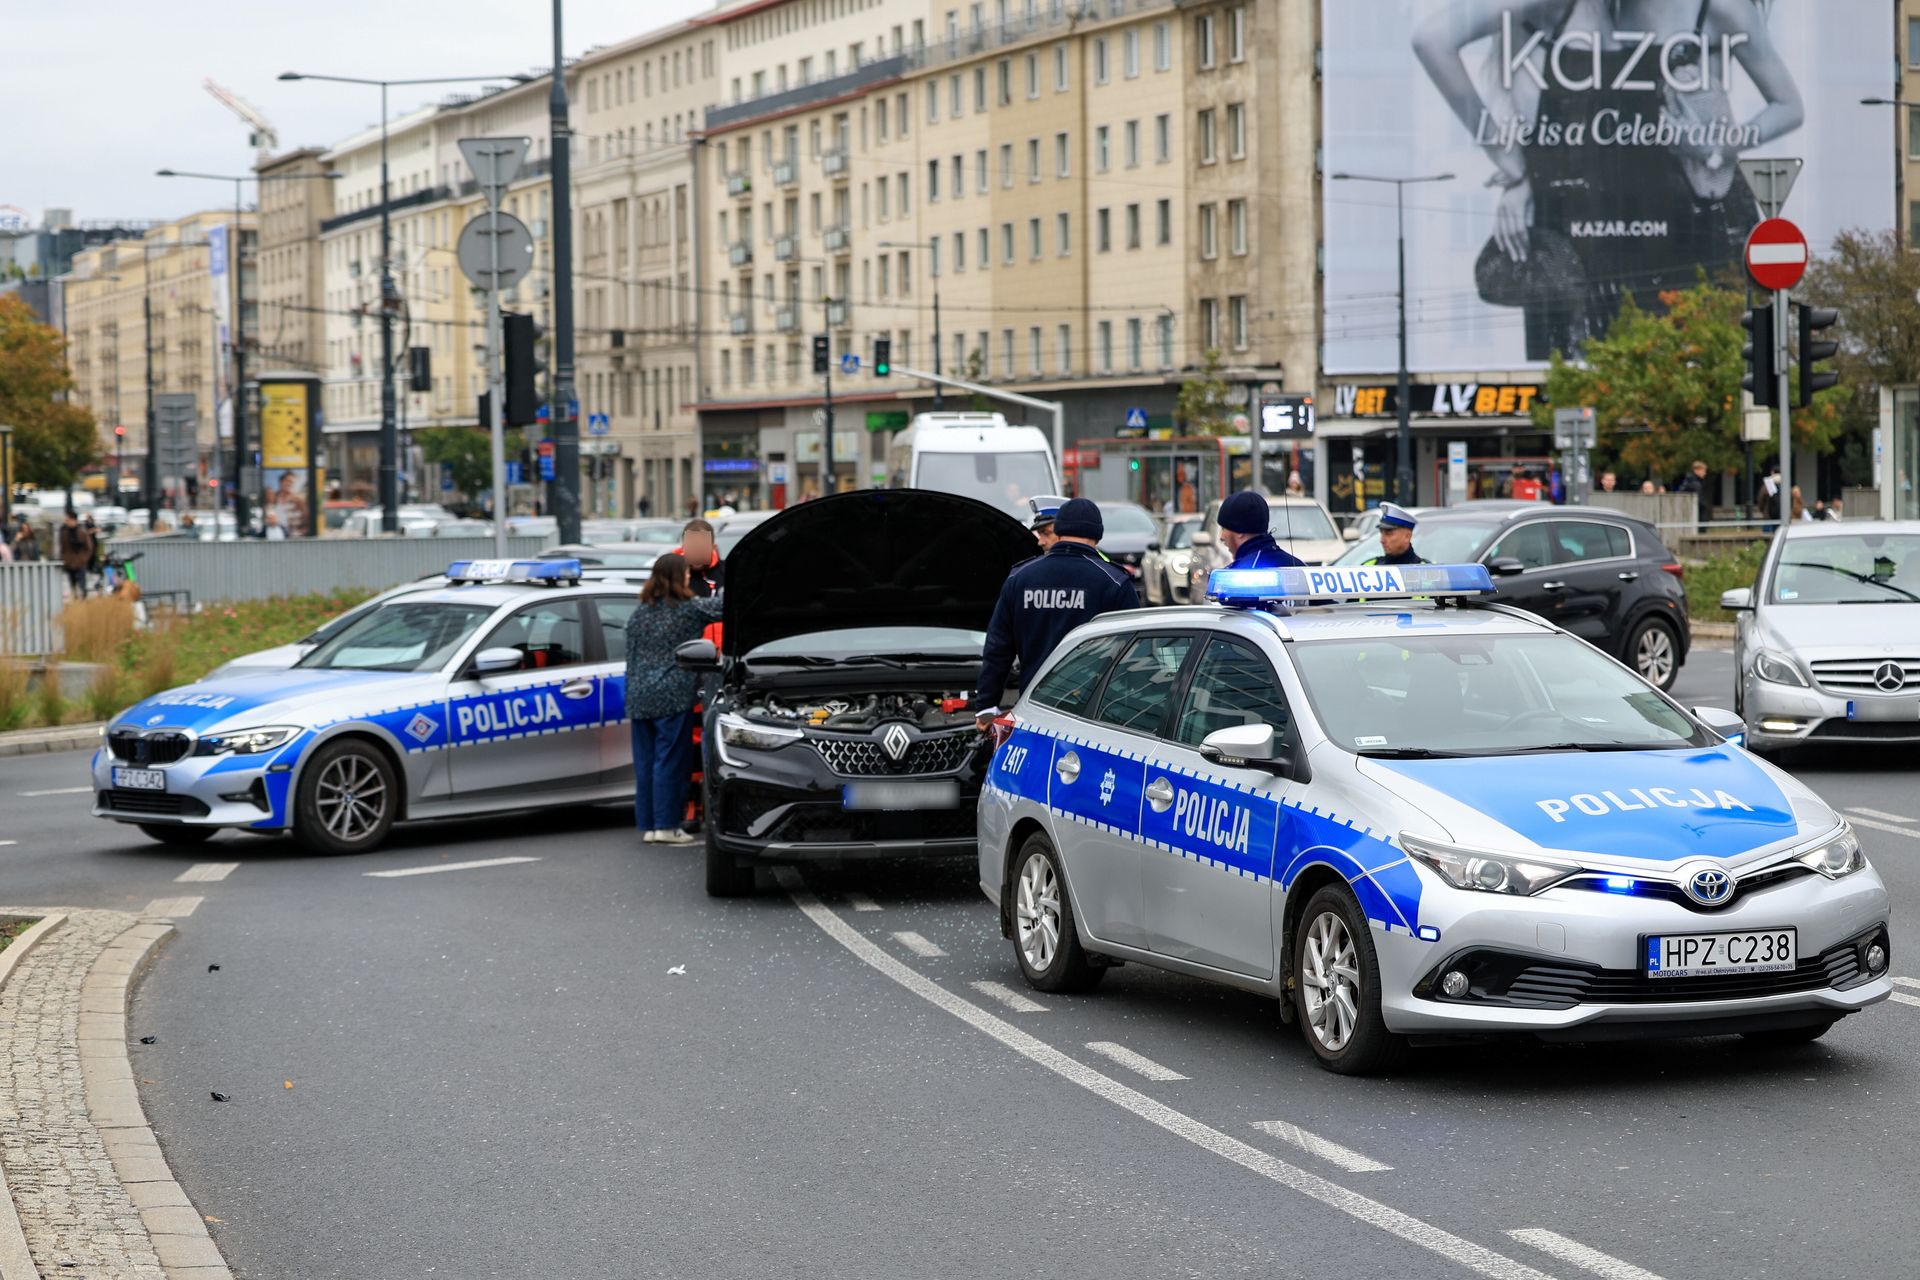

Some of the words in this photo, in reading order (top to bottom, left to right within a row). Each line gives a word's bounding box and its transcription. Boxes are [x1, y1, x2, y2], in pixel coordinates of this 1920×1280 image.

[1502, 9, 1748, 91] kazar
[1476, 109, 1533, 152] Life
[1538, 115, 1560, 146] is
[1564, 123, 1584, 146] a
[1591, 108, 1760, 147] Celebration
[1571, 220, 1668, 237] KAZAR.COM
[470, 563, 506, 577] POLICJA
[1310, 570, 1400, 593] POLICJA
[1024, 589, 1085, 609] POLICJA
[457, 693, 563, 736] POLICJA
[1172, 787, 1250, 855] POLICJA
[1535, 787, 1755, 823] POLICJA
[1649, 958, 1659, 966] PL
[1666, 938, 1716, 968] HPZ
[1727, 933, 1790, 964] C238
[1652, 969, 1688, 977] MOTOCARS
